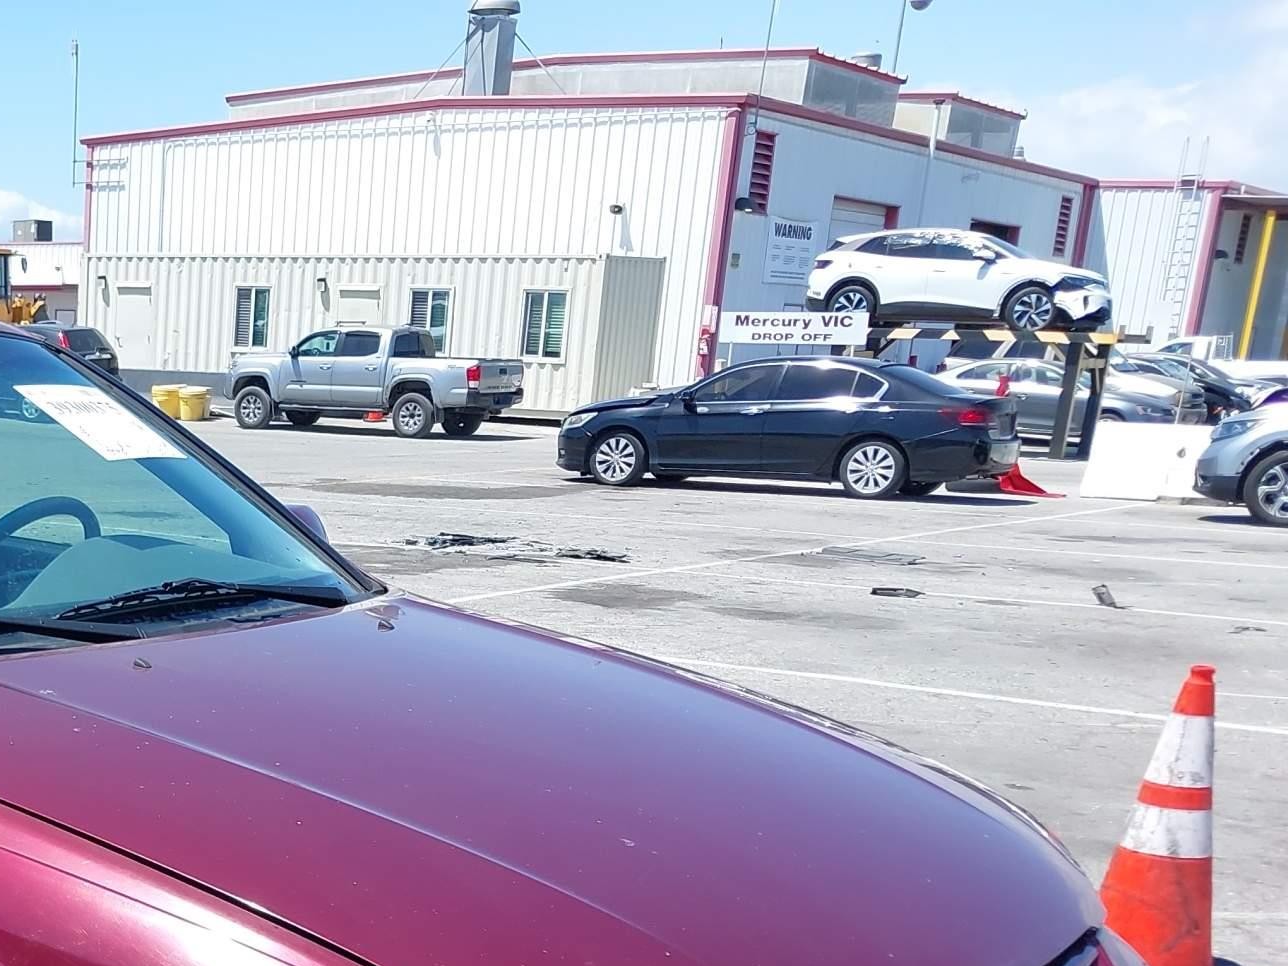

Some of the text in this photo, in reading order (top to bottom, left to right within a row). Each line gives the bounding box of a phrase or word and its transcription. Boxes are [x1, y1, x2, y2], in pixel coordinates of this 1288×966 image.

[774, 222, 812, 241] WARNING
[735, 314, 812, 330] Mercury
[821, 315, 854, 328] VIC
[751, 332, 833, 342] DROP OFF
